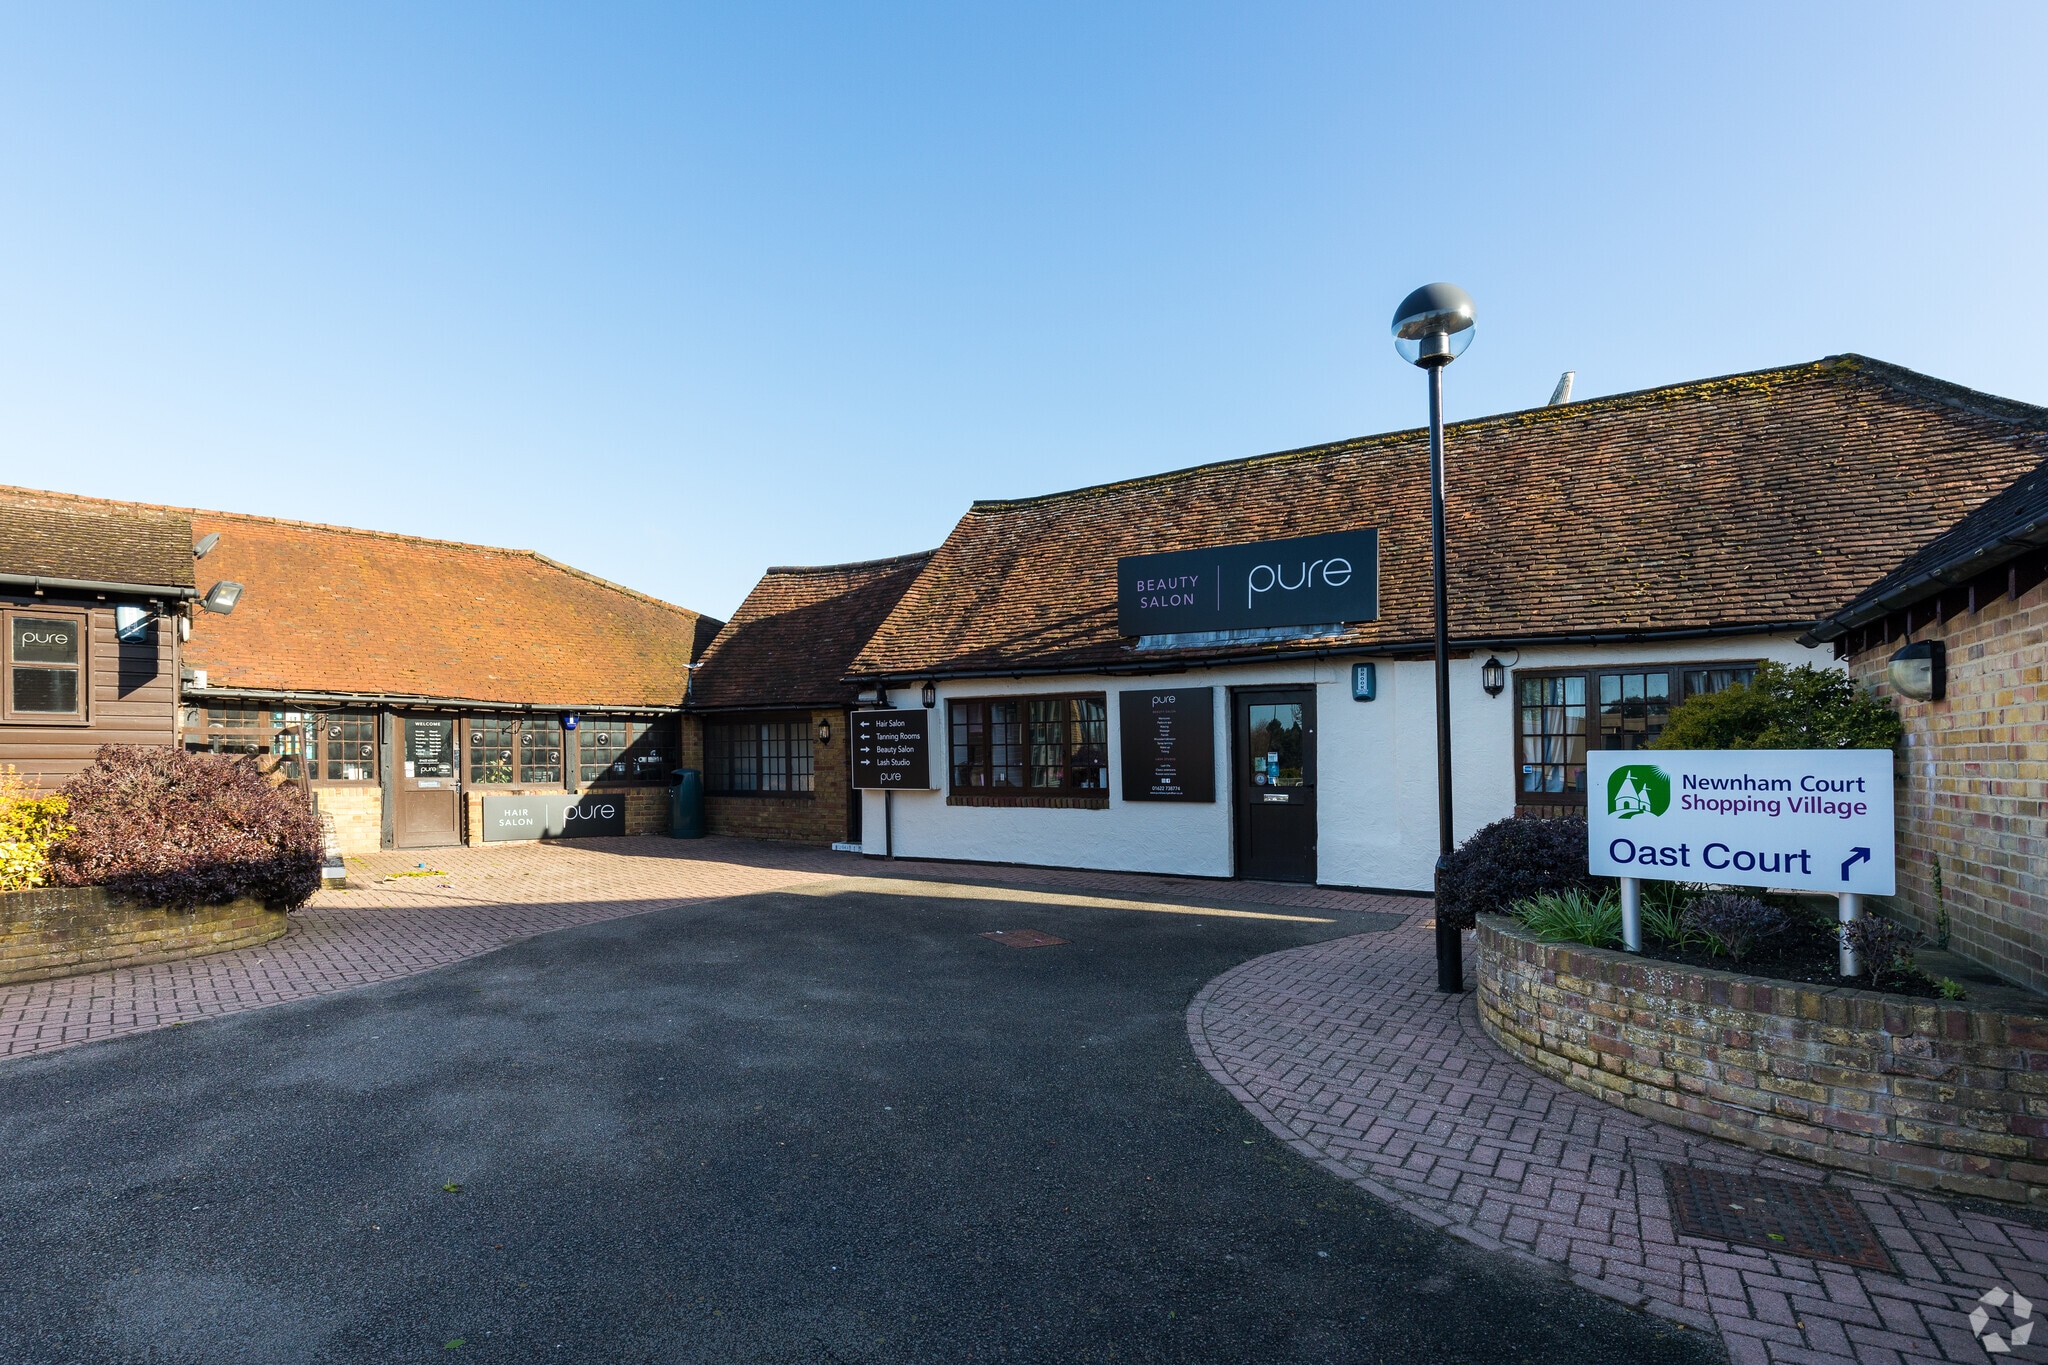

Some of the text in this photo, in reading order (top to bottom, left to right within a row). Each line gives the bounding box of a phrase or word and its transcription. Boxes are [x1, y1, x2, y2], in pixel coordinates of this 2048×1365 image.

[1137, 575, 1199, 592] BEAUTY
[1248, 558, 1352, 609] pure
[1140, 593, 1194, 609] SALON
[22, 632, 68, 647] pure
[1152, 695, 1176, 708] pure
[888, 719, 905, 727] Salon
[876, 732, 921, 742] Tanning Rooms
[876, 745, 914, 755] Beauty Salon
[876, 758, 911, 766] Lash Studio
[420, 766, 437, 774] pure
[880, 772, 902, 785] pure
[1682, 774, 1866, 793] Newnham Court
[504, 808, 529, 817] HAIR
[1681, 794, 1868, 819] Shopping Village
[498, 818, 534, 827] SALON
[563, 804, 615, 828] pure
[1609, 838, 1812, 875] Oast Court
